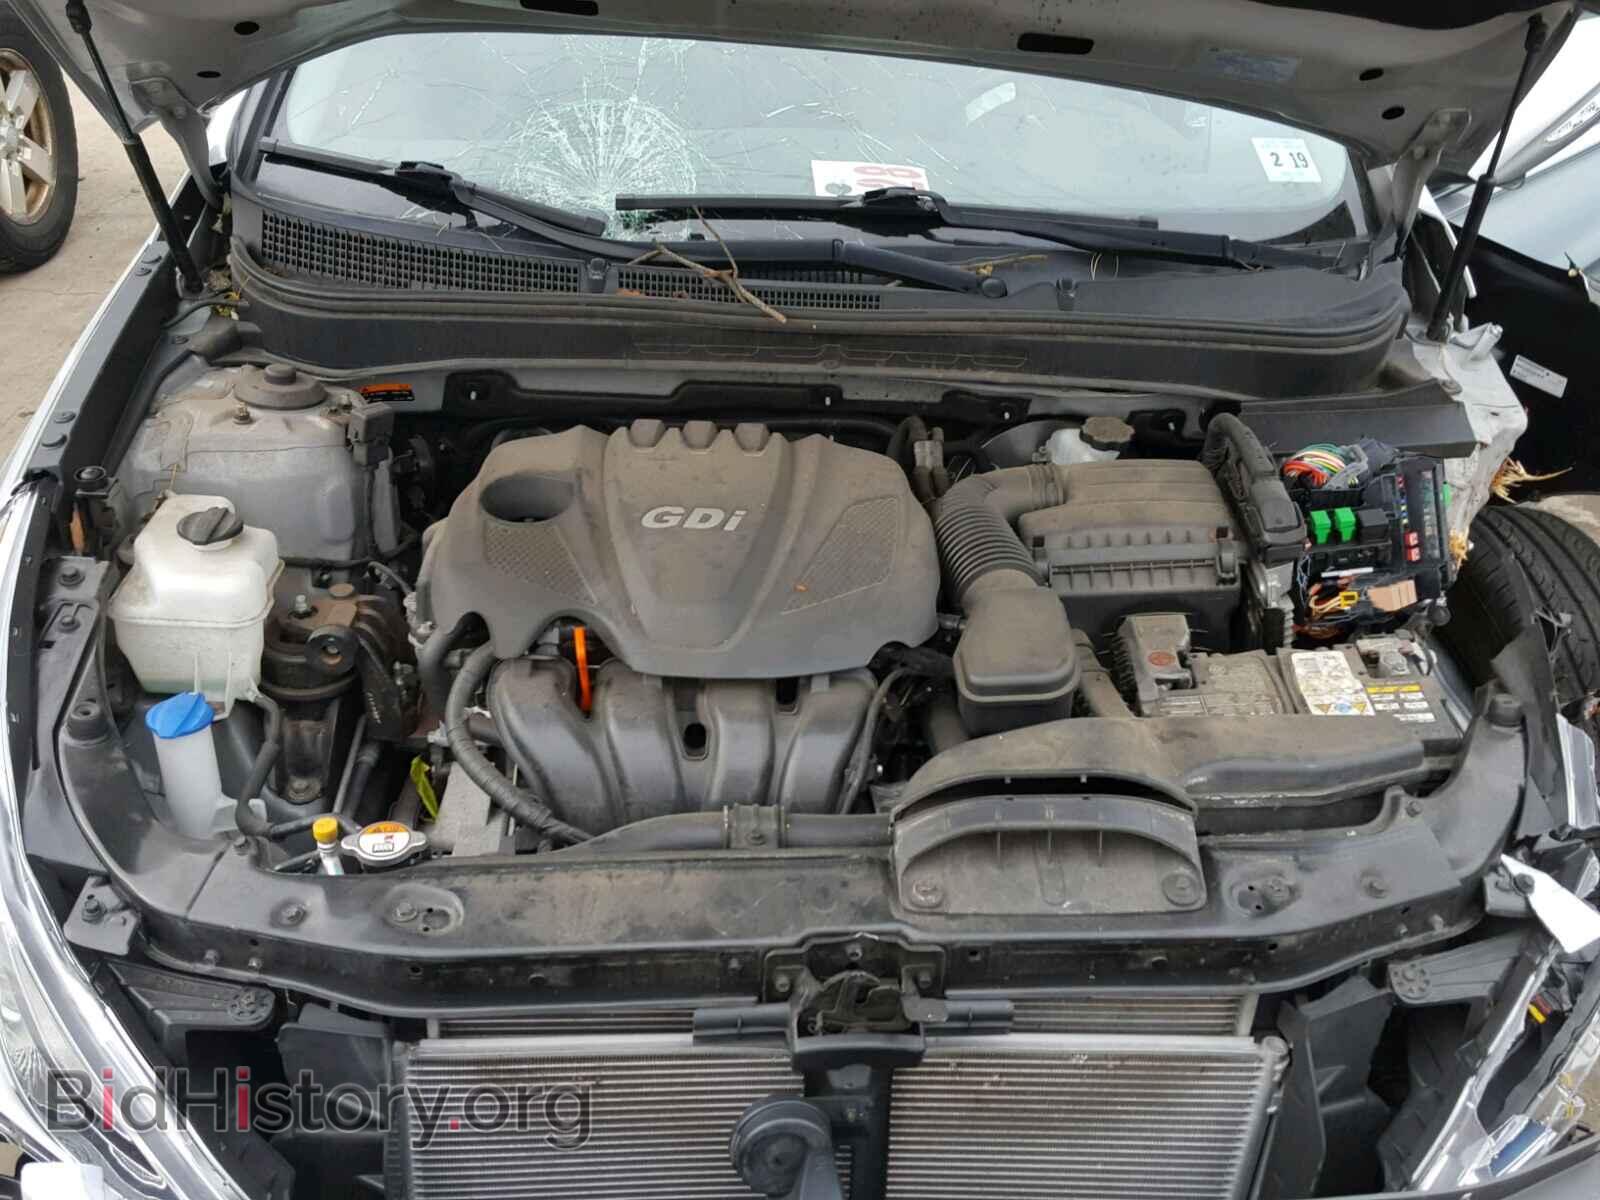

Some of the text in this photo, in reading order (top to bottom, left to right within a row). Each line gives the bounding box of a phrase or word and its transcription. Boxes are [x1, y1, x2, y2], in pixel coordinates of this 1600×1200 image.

[1269, 151, 1309, 168] 2 19
[640, 505, 748, 531] GDi
